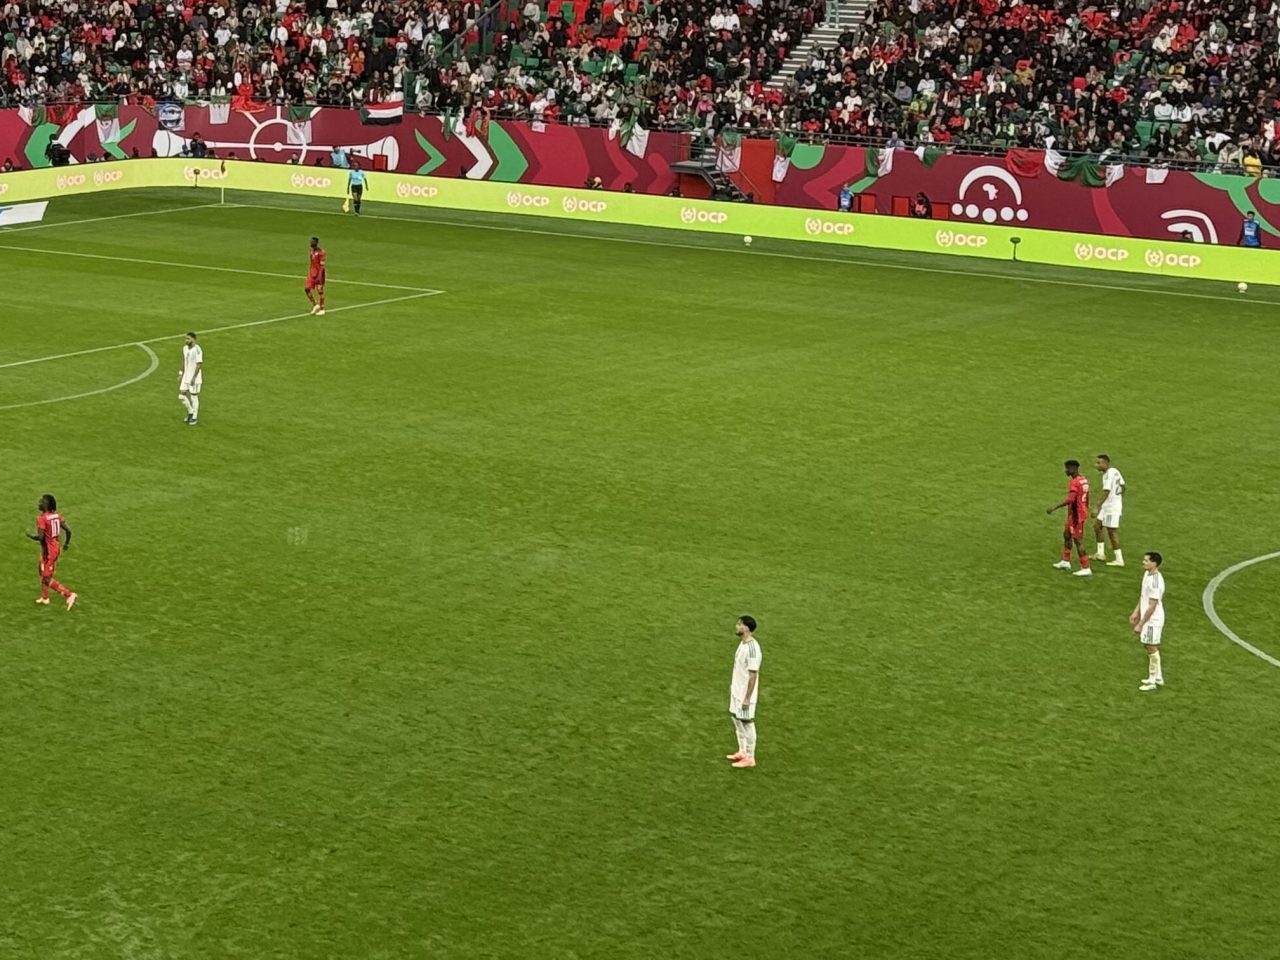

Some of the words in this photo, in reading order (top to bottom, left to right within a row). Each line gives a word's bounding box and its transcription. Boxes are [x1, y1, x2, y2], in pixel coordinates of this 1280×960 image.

[67, 174, 86, 186] OCP
[103, 170, 123, 181] OCP
[306, 176, 331, 188] OCP
[412, 185, 438, 197] OCP
[523, 194, 549, 207] OCP
[578, 200, 607, 212] OCP
[697, 210, 728, 224] OCP
[822, 221, 854, 235] OCP
[954, 233, 988, 247] OCP
[1094, 247, 1129, 261] OCP
[1165, 253, 1201, 268] OCP
